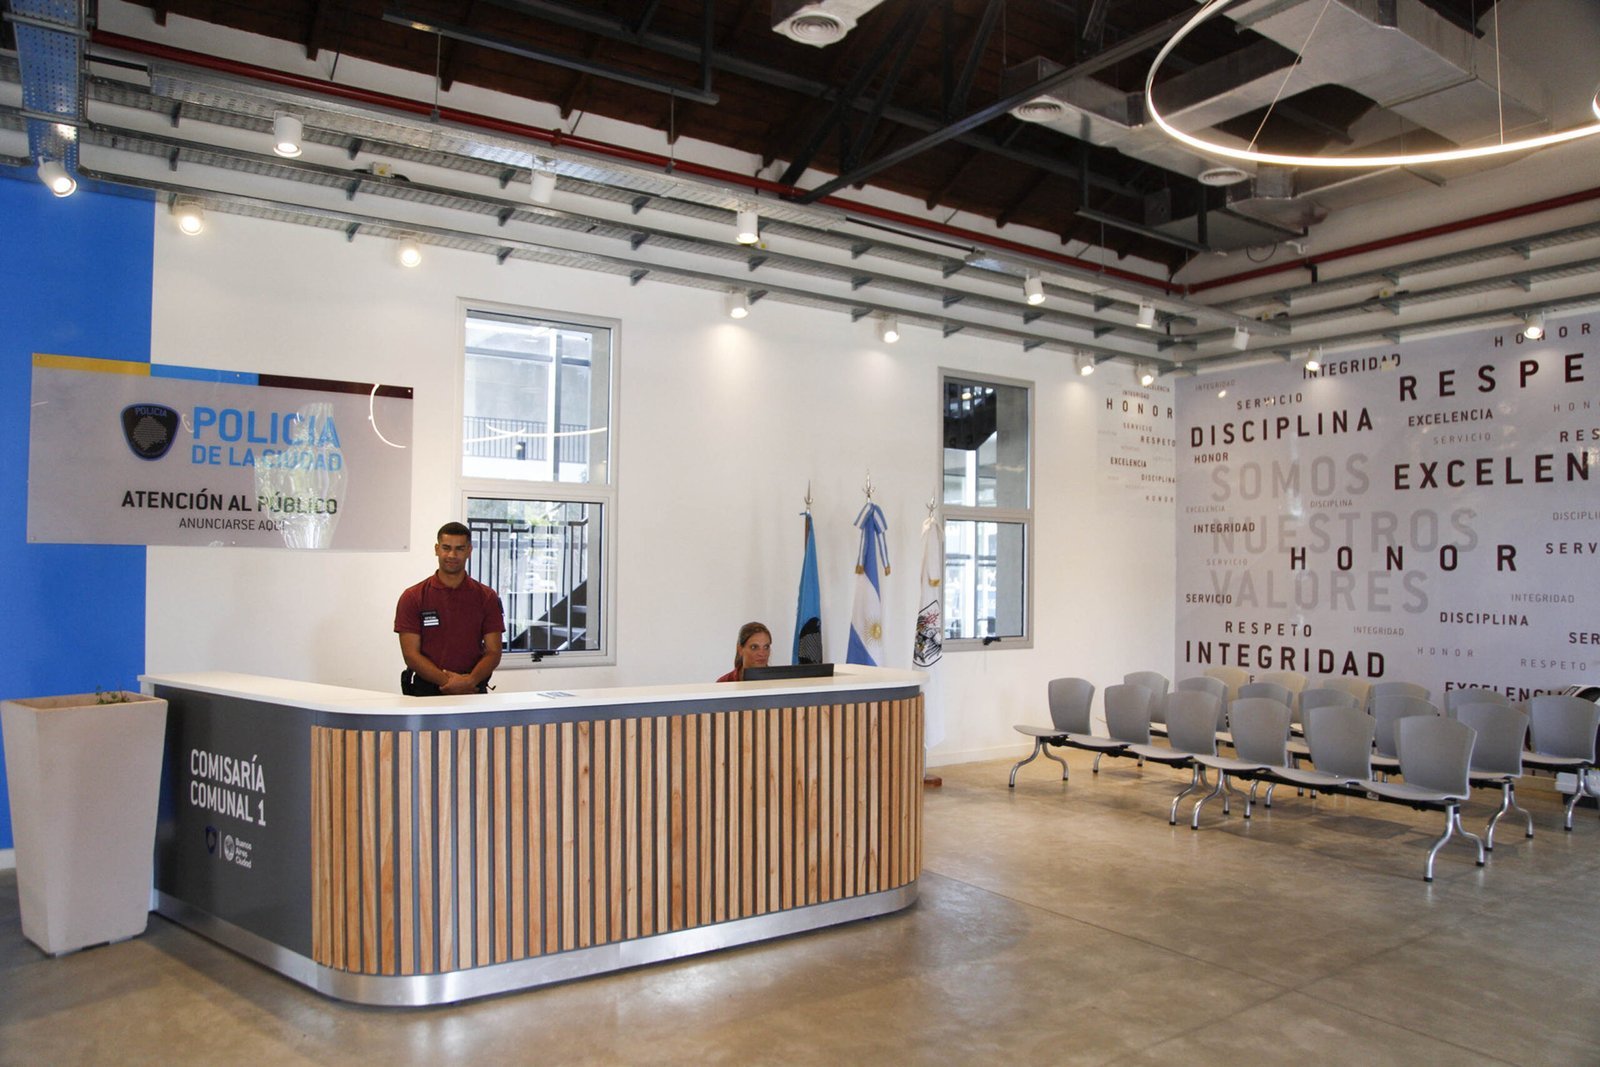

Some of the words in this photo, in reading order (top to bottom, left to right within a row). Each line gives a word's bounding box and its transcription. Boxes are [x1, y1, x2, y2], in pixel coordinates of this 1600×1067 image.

[1400, 353, 1584, 401] RESPE
[1106, 398, 1173, 419] HONOR
[1236, 393, 1303, 410] SERVICIO
[1553, 401, 1600, 412] HON
[1408, 408, 1494, 427] EXCELENCIA
[1191, 408, 1374, 448] DISCIPLINA
[1560, 428, 1600, 442] RES
[1140, 435, 1176, 447] RESPETO
[1434, 432, 1491, 445] SERVICIO
[192, 444, 221, 465] DE
[229, 447, 255, 467] LA
[1110, 456, 1147, 468] EXCELENCIA
[1194, 452, 1229, 464] HONOR
[1211, 453, 1370, 502] SOMOS
[1394, 452, 1589, 490] EXCELEN
[121, 487, 223, 511] ATENCIÓN
[228, 495, 252, 512] AL
[257, 491, 338, 514] PÚBLICO
[1310, 500, 1353, 508] DISCIPLINA
[1552, 511, 1600, 521] DISCIPLI
[178, 517, 255, 531] ANUNCIARSE
[1193, 522, 1256, 534] INTEGRIDAD
[1212, 508, 1478, 555] NUESTROS
[1545, 542, 1598, 555] SERV
[1291, 544, 1517, 572] HONOR
[1186, 593, 1232, 604] SERVICIO
[1210, 569, 1429, 614] VALORES
[1511, 594, 1575, 604] INTEGRIDAD
[1440, 612, 1529, 626] DISCIPLINA
[1225, 621, 1313, 637] RESPETO
[1353, 626, 1404, 636] INTEGRIDAD
[1569, 632, 1600, 645] SER
[1186, 640, 1385, 678] INTEGRIDAD
[1417, 647, 1474, 657] HONOR
[1520, 659, 1587, 671] RESPETO
[190, 749, 266, 794] COMISARÍA
[190, 780, 253, 822] COMUNAL
[257, 800, 266, 826] 1
